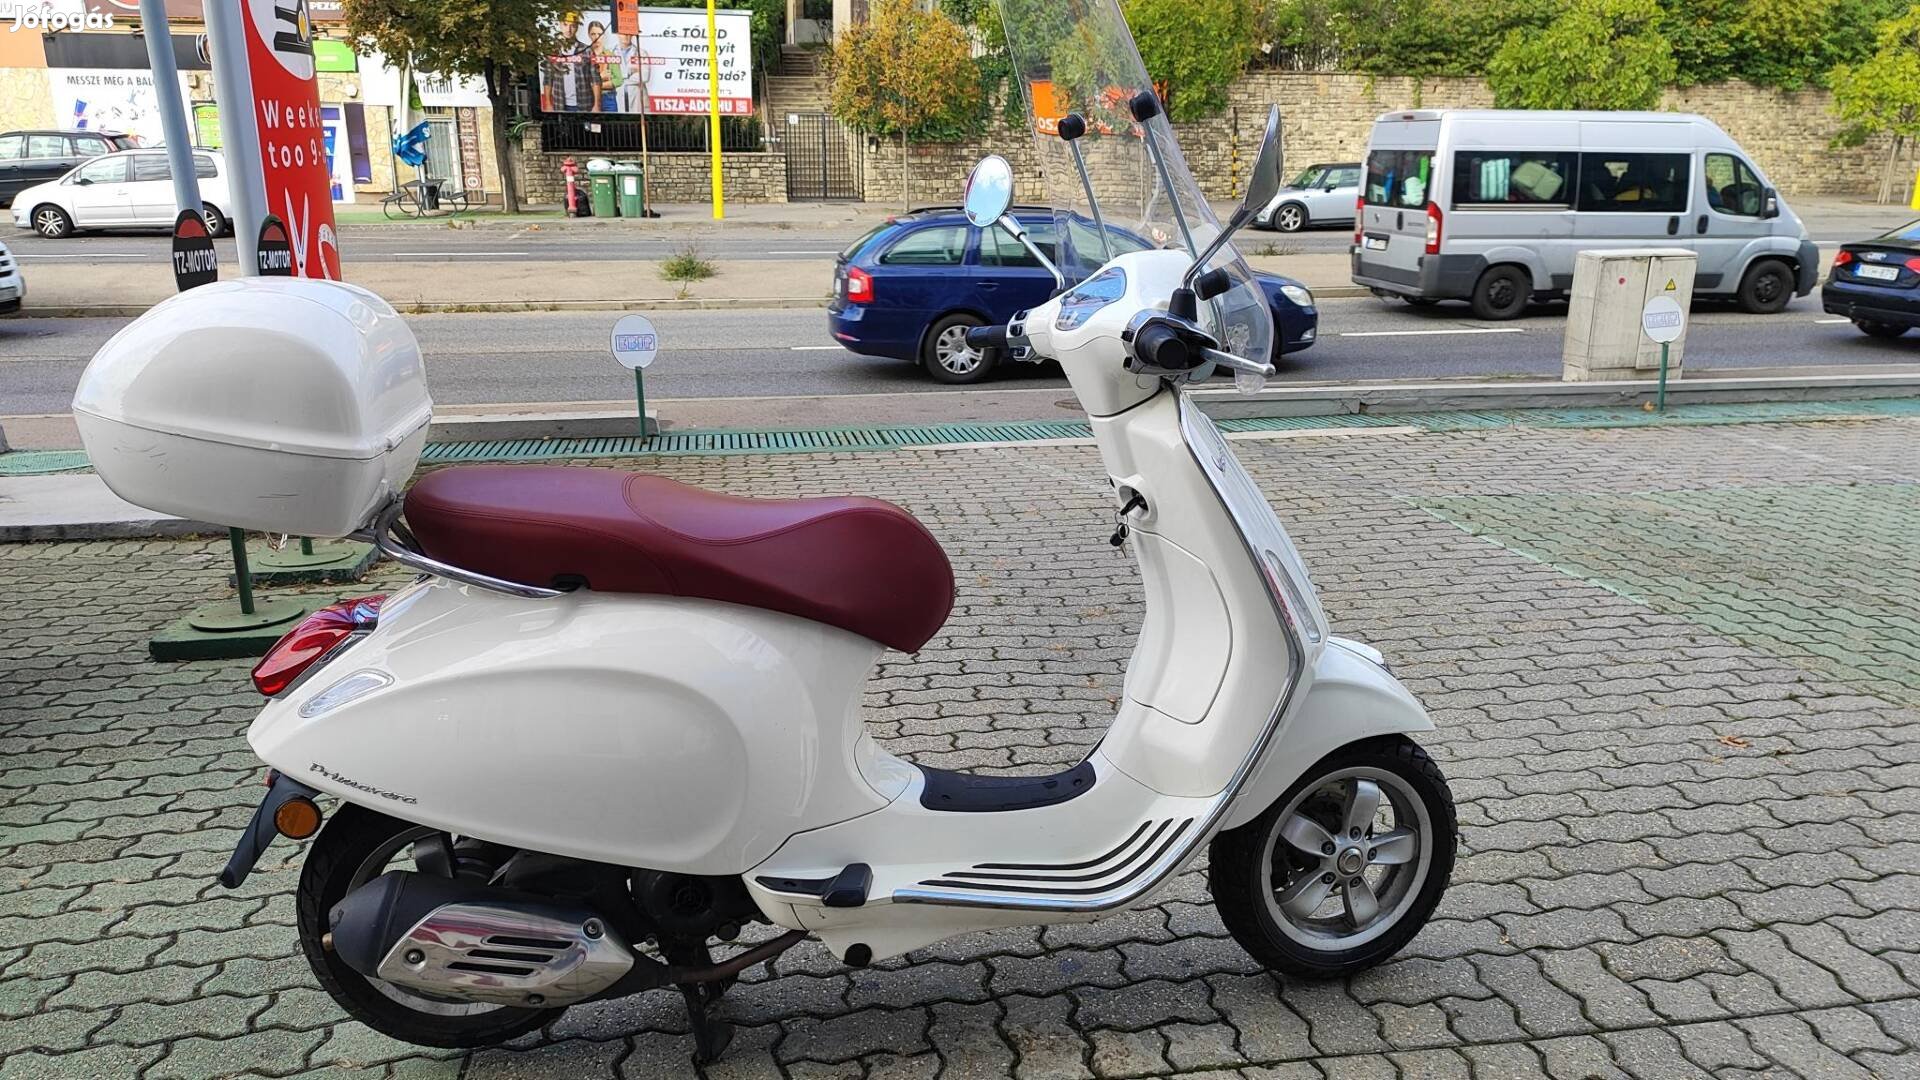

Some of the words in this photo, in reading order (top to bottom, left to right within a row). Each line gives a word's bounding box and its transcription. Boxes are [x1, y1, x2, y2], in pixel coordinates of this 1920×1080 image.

[682, 25, 727, 39] TŐLD
[723, 57, 734, 67] el
[67, 75, 100, 86] MESSZE
[104, 76, 124, 86] MEG
[127, 77, 134, 86] A
[664, 72, 672, 80] a
[267, 141, 304, 169] too
[174, 249, 217, 274] TZ-MOTOR
[259, 250, 291, 269] TZ-MOTOR
[310, 763, 417, 804] Primavera
